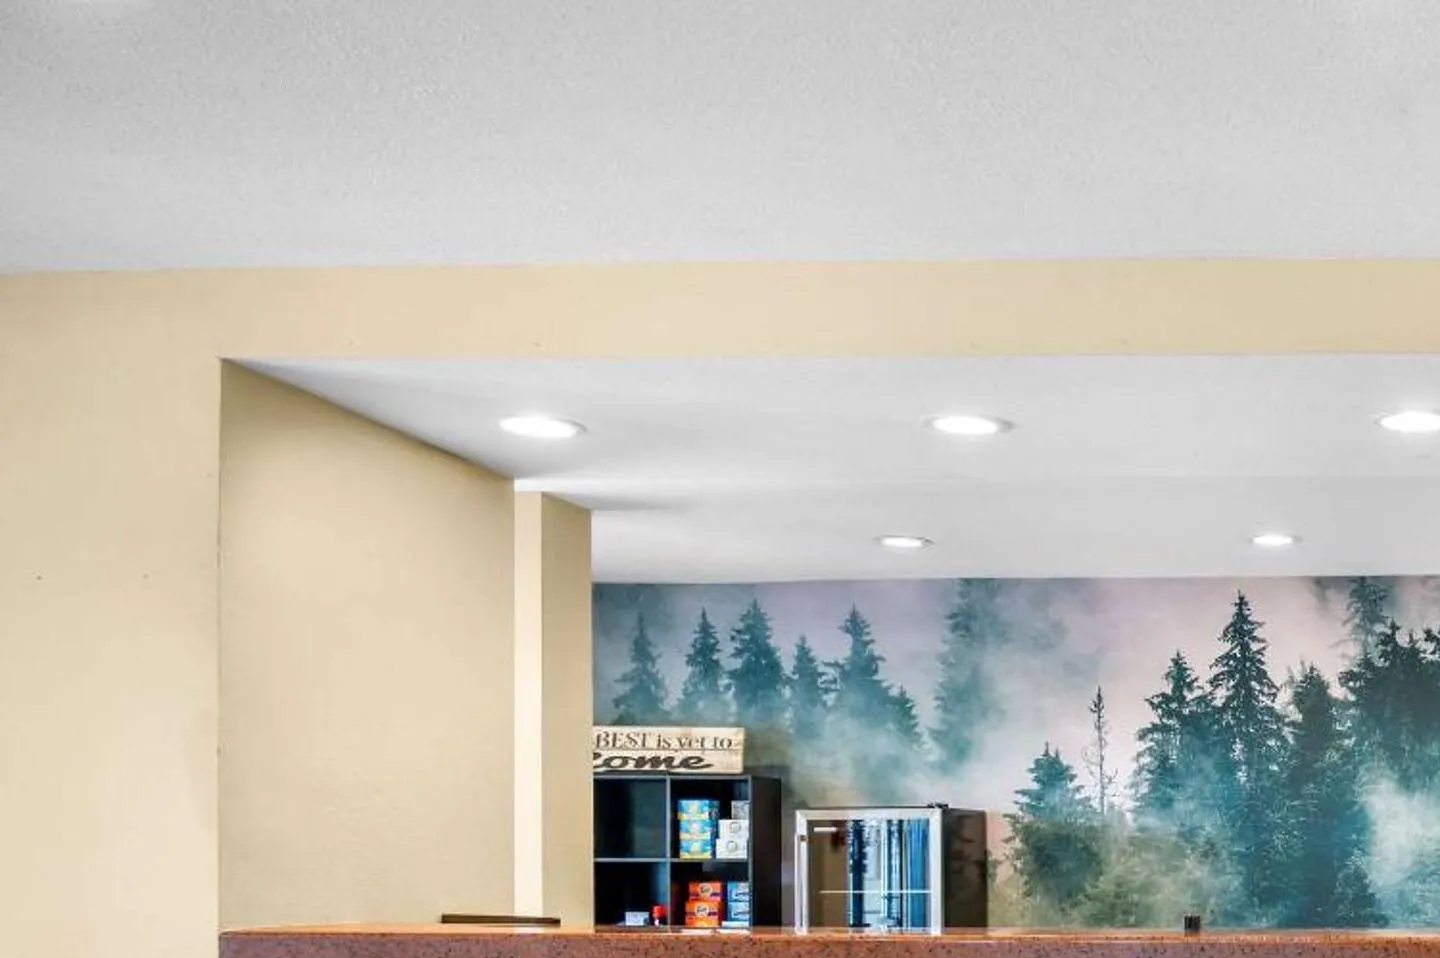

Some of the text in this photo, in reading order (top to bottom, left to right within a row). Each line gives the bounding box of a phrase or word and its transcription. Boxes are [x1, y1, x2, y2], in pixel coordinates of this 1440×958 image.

[595, 731, 733, 753] BEST is yet to
